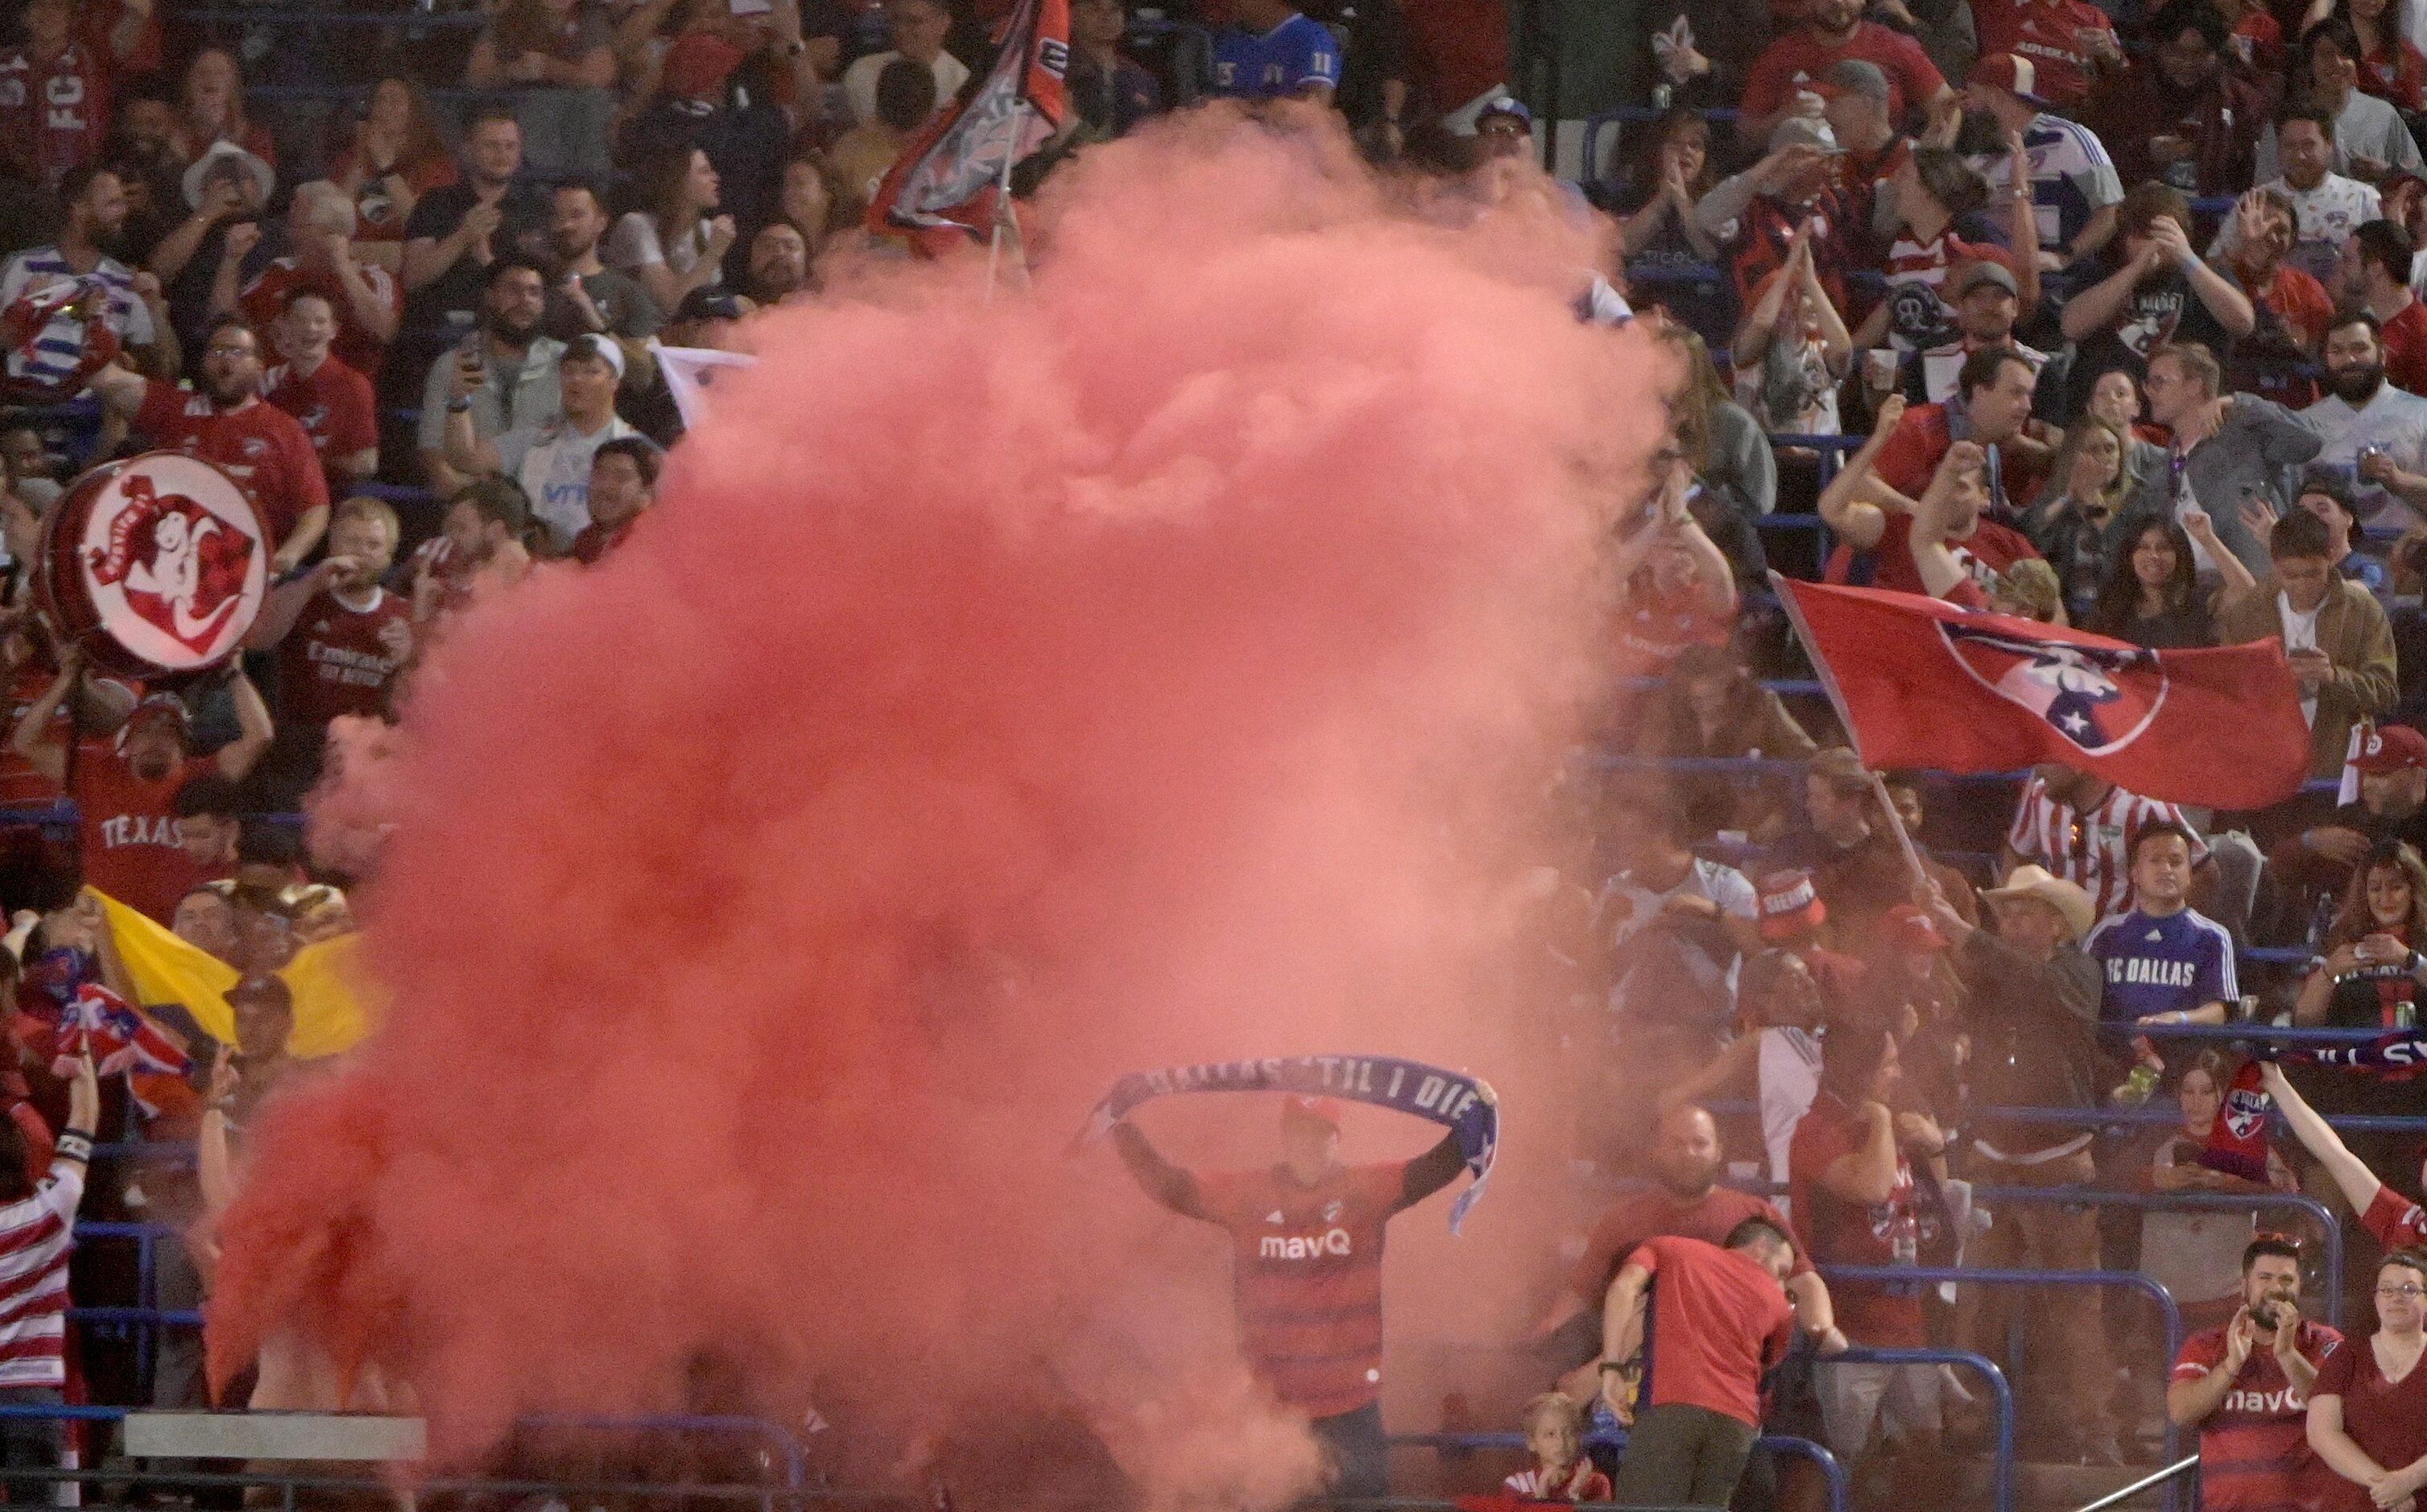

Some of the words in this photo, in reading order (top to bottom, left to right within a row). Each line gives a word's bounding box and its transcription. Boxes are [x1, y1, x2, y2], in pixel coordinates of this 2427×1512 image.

[101, 814, 184, 849] TEXAS
[2126, 958, 2195, 988] DALLAS
[1388, 1067, 1407, 1099] I
[1415, 1075, 1481, 1121] DIE
[1260, 1228, 1352, 1259] mavQ
